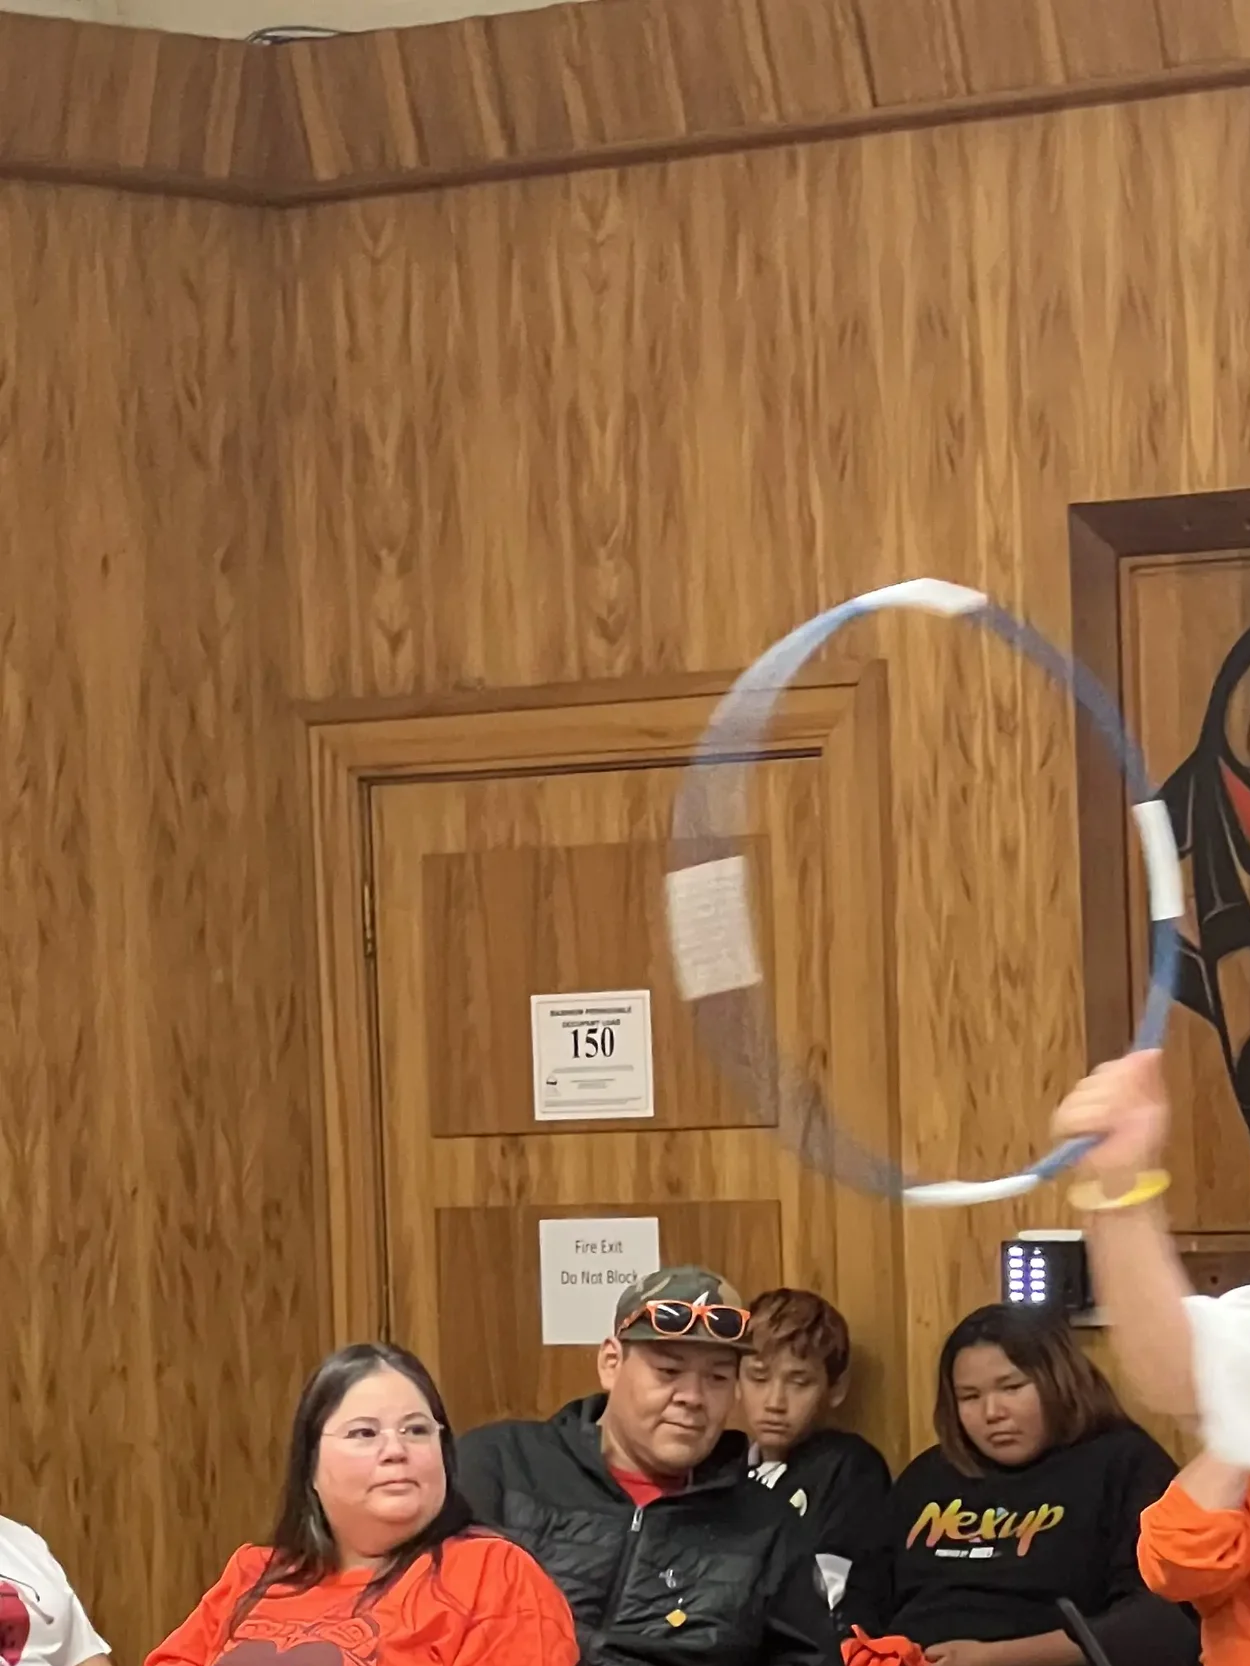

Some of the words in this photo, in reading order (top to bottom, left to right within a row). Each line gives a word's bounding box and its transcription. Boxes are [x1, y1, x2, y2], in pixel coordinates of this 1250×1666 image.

[571, 1026, 615, 1059] 150
[575, 1239, 598, 1254] Fire
[601, 1239, 623, 1254] Exit
[561, 1270, 578, 1285] Do
[581, 1270, 603, 1284] Not
[606, 1269, 638, 1284] Block
[906, 1499, 1065, 1558] Nexup
